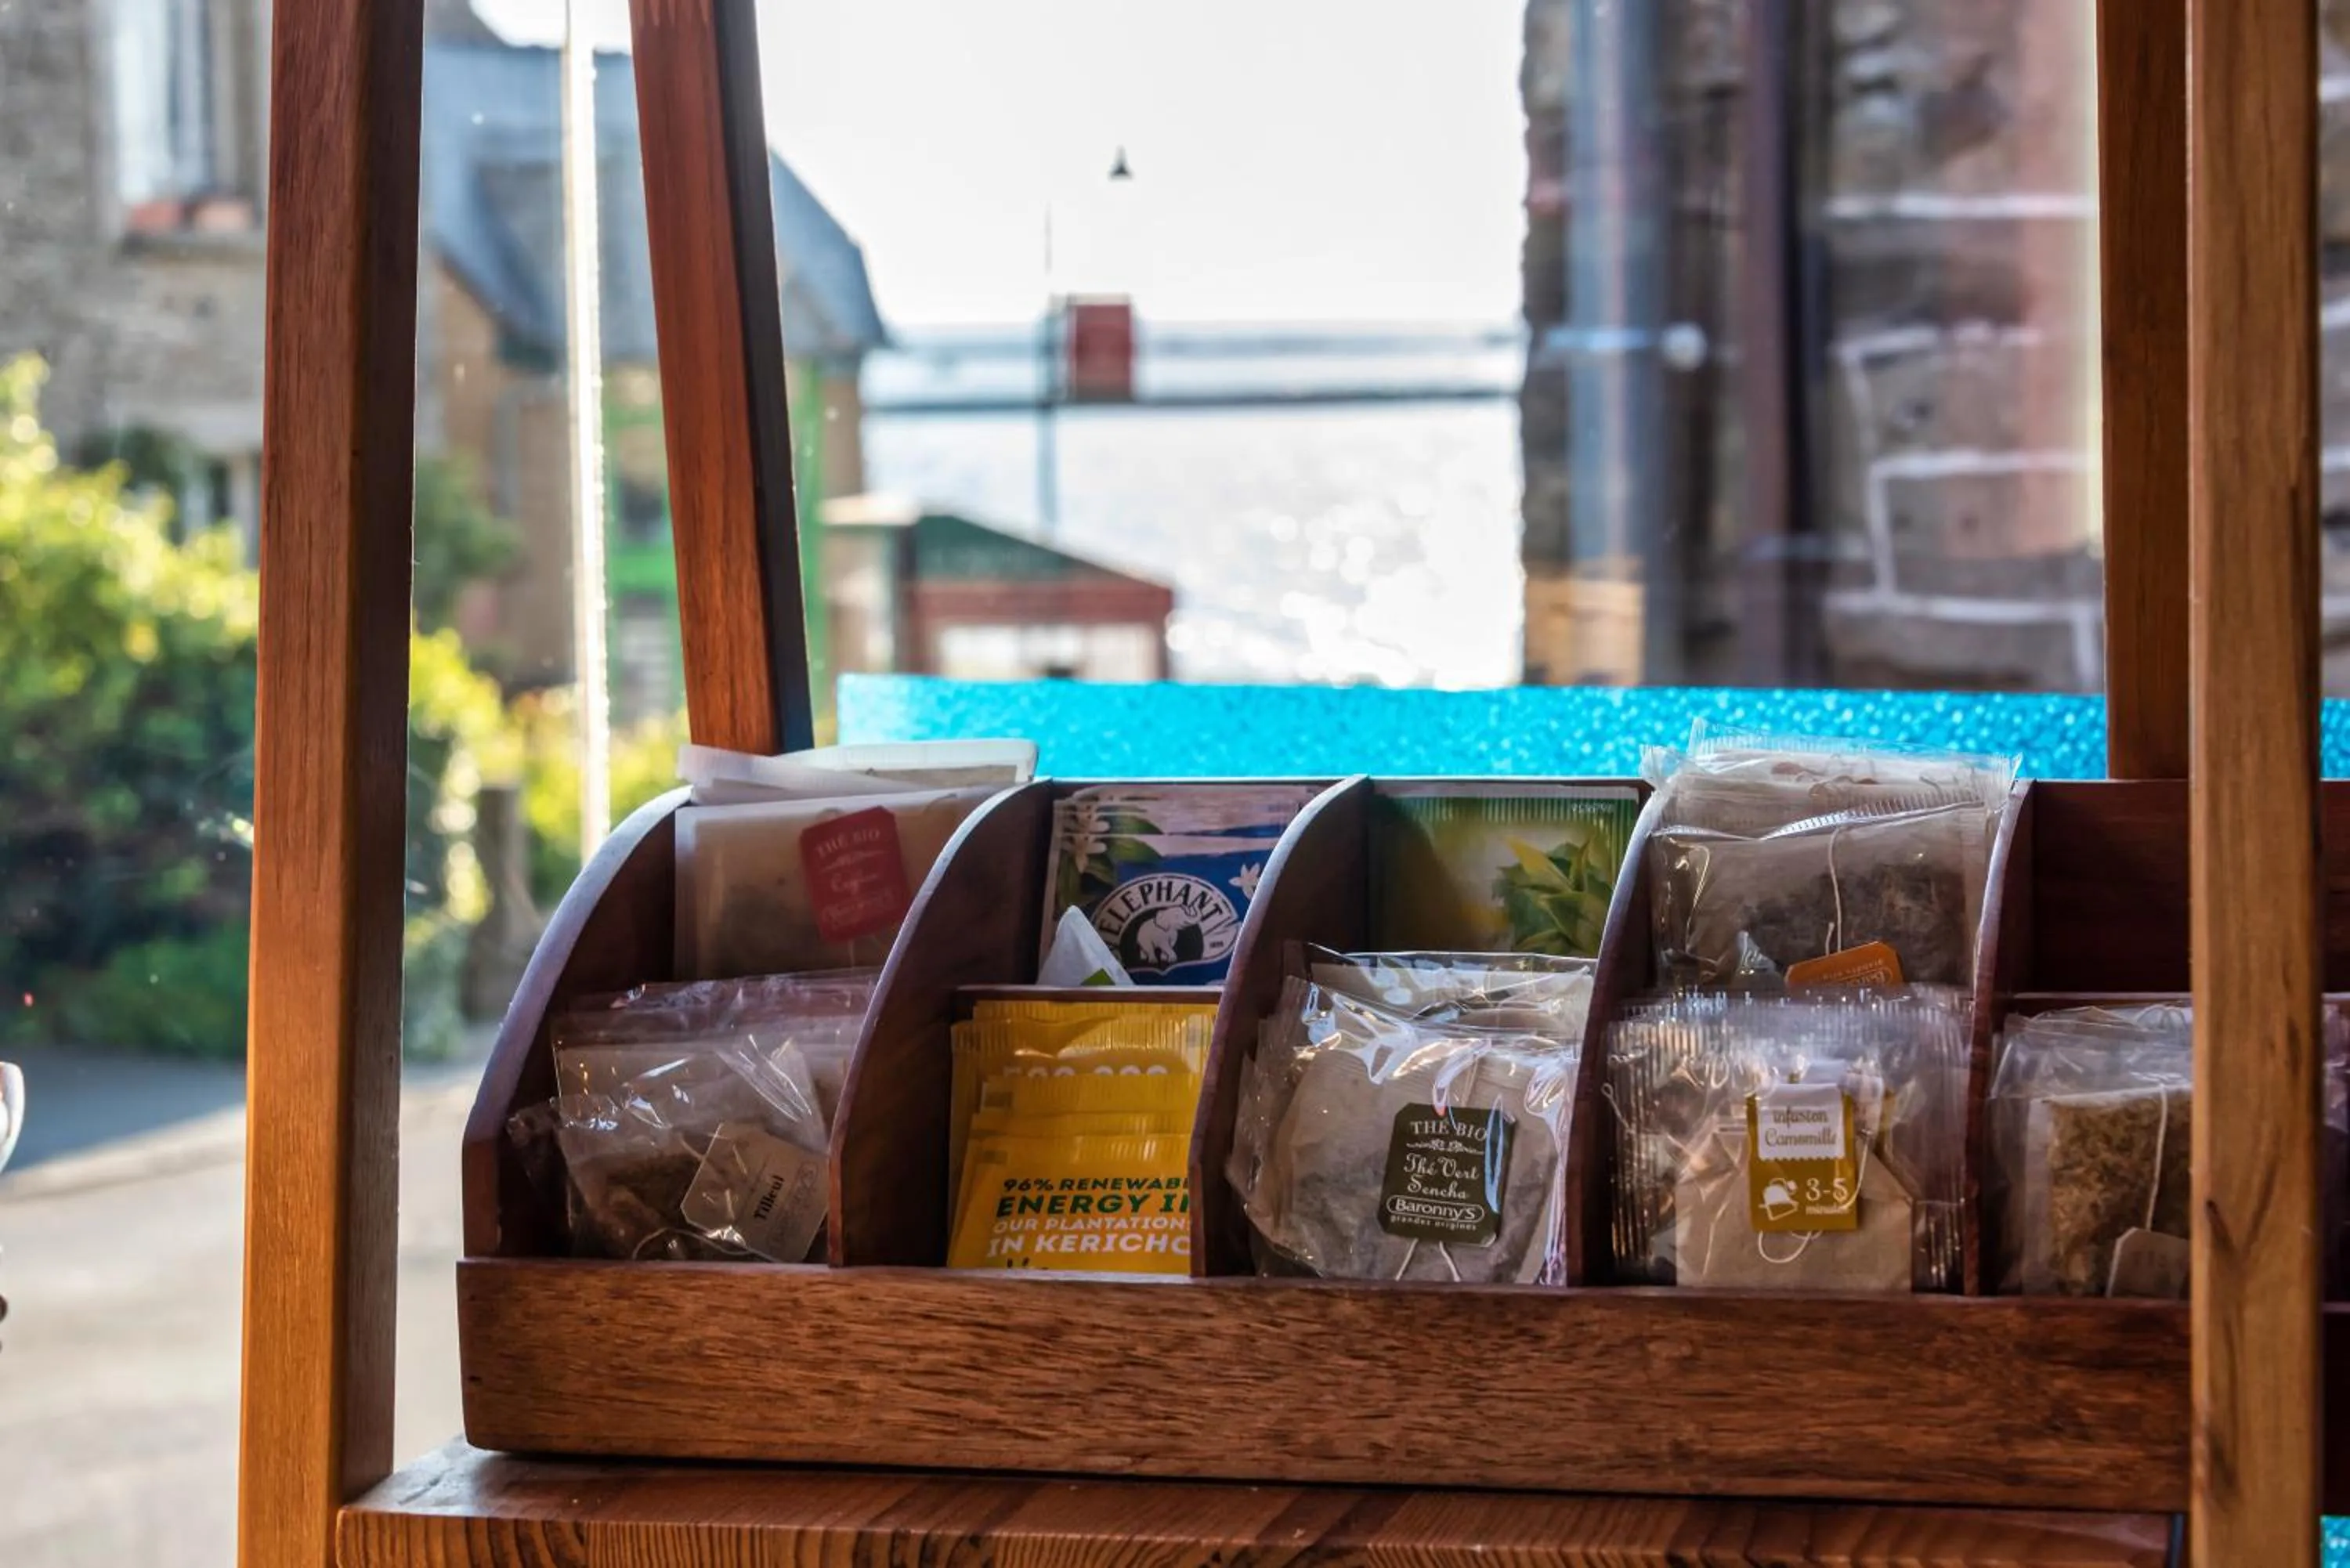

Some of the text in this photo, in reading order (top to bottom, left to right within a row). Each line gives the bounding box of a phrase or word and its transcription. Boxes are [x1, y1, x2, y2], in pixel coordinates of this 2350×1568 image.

[1099, 880, 1223, 936] ELEPHANT
[1455, 1122, 1488, 1141] BIO
[1765, 1127, 1836, 1147] Camomille
[1438, 1156, 1480, 1180] Vert
[1003, 1178, 1054, 1191] 96%
[1407, 1173, 1469, 1200] Sencha
[1806, 1176, 1849, 1202] 3-5
[753, 1174, 785, 1223] Tilleul
[996, 1193, 1150, 1218] ENERGY
[992, 1216, 1190, 1234] OUR PLANTATION
[986, 1235, 1025, 1258] IN
